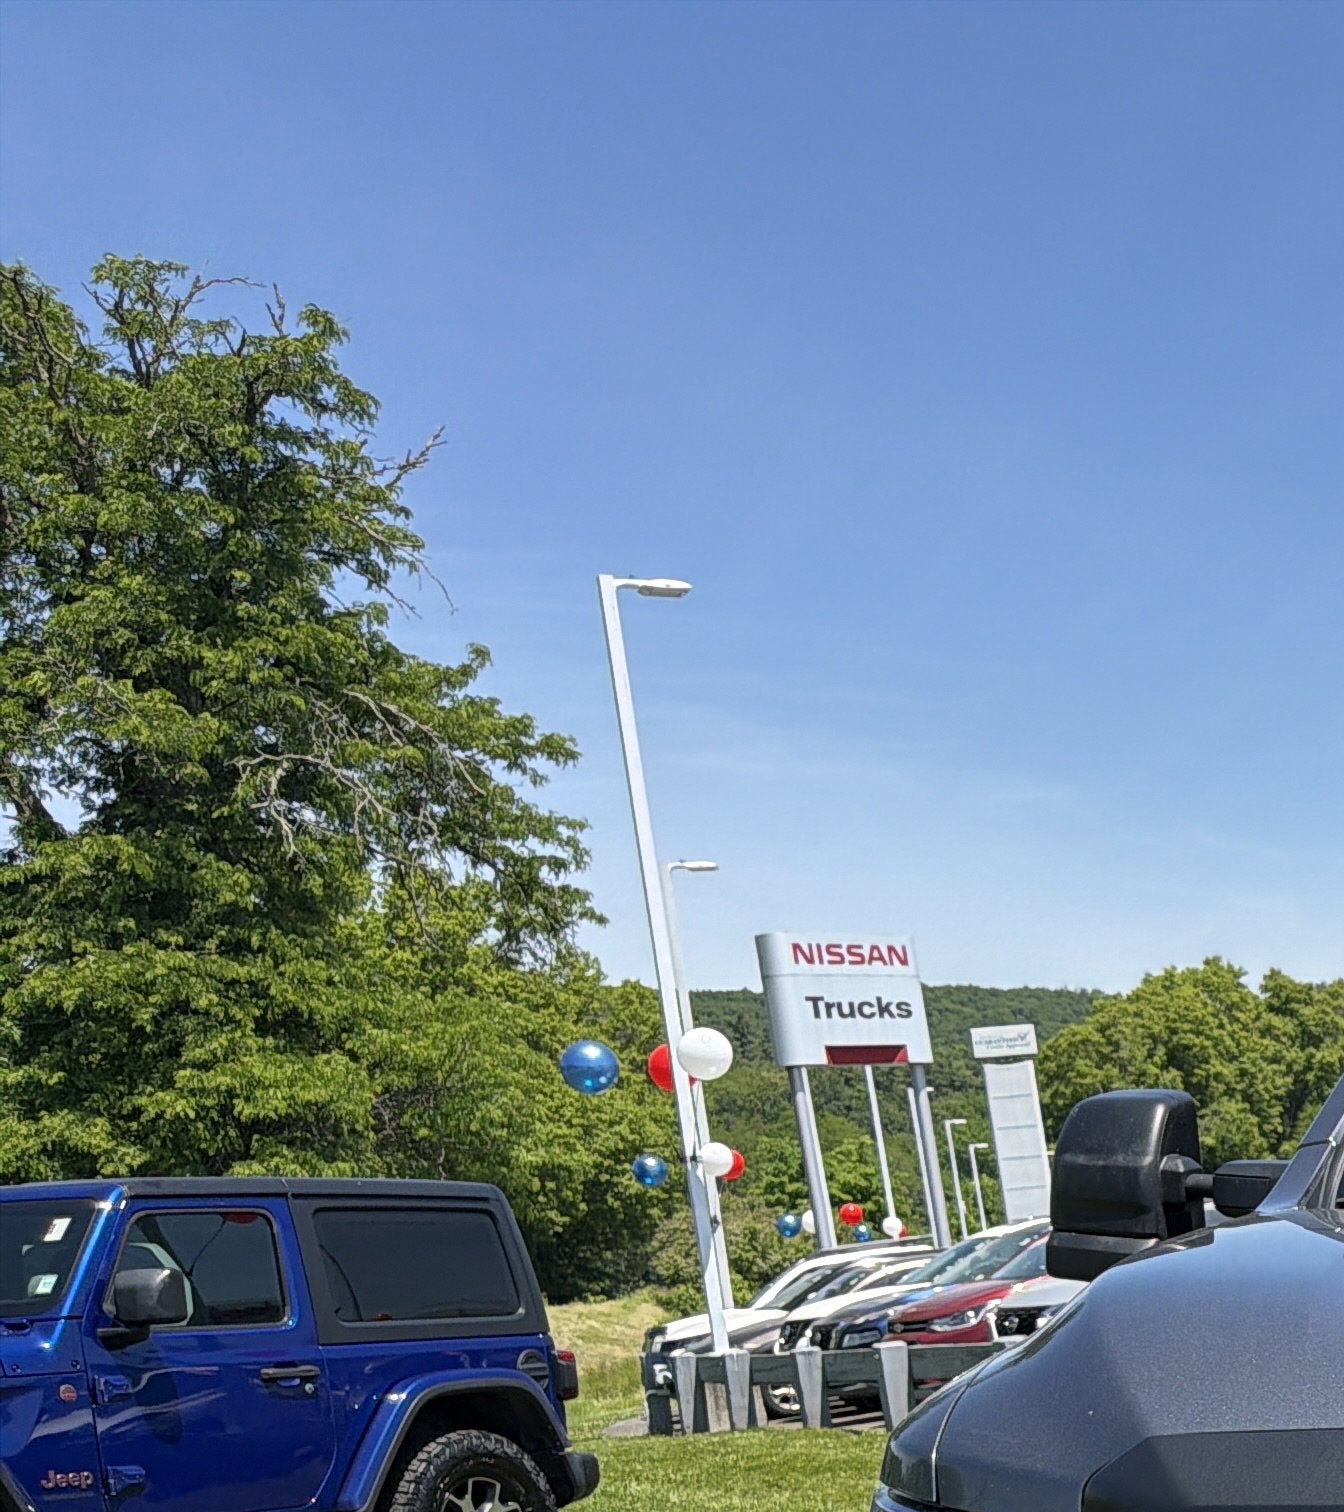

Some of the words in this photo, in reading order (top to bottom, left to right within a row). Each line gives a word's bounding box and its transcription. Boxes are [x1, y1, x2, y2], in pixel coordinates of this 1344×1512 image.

[791, 942, 909, 967] NISSAN
[804, 995, 913, 1019] Trucks
[40, 1469, 94, 1489] Jeep
